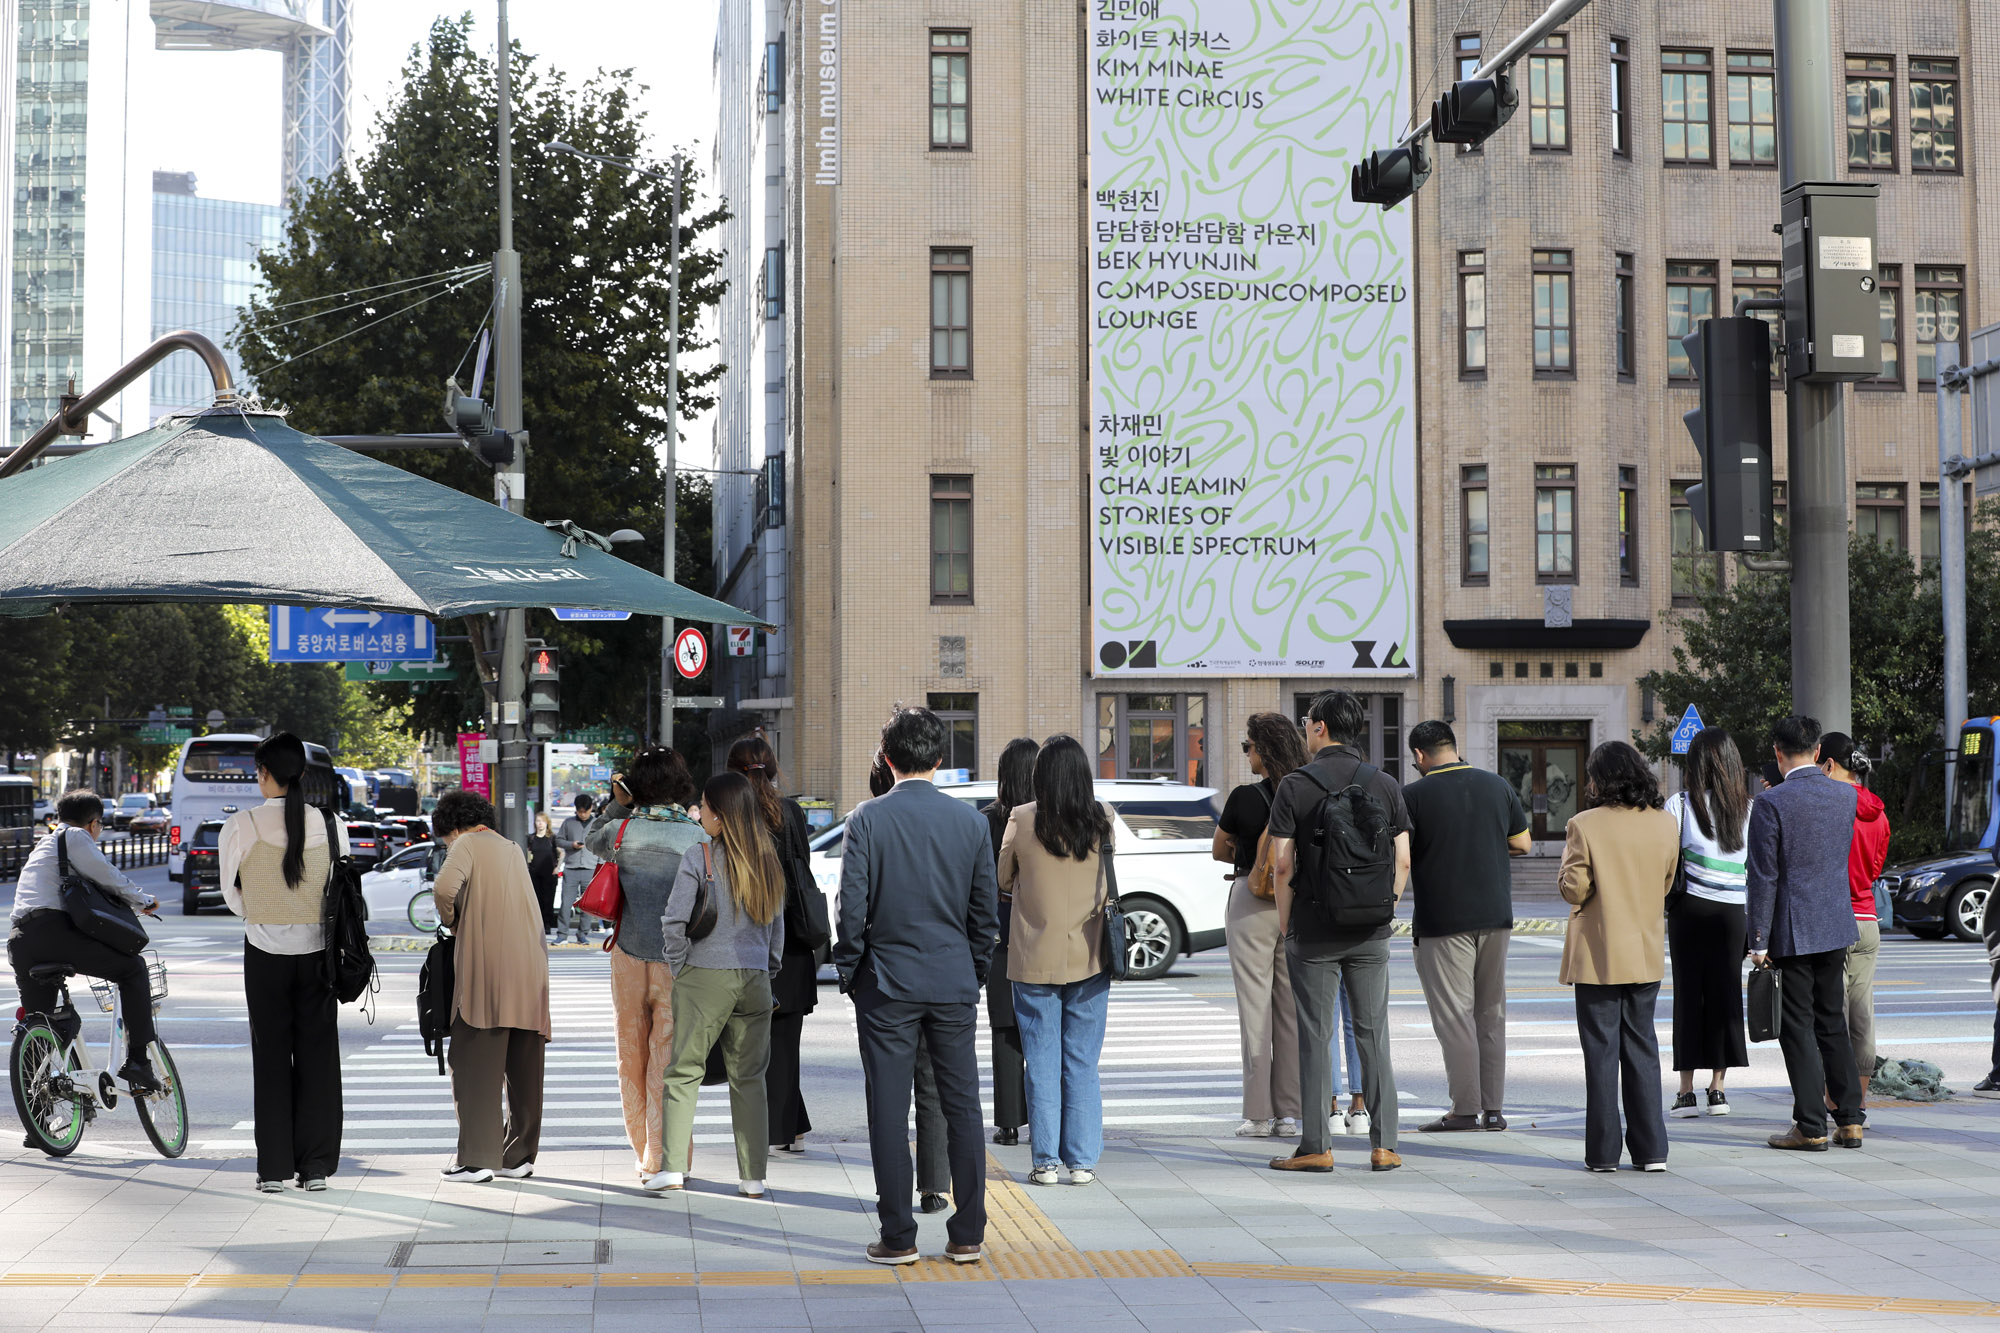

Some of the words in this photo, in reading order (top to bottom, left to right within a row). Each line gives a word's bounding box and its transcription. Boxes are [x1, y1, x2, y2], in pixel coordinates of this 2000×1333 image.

[1097, 0, 1159, 21] 김민애
[1096, 29, 1158, 51] 화이트
[1168, 30, 1231, 52] 서커스
[819, 13, 836, 118] museum
[1097, 59, 1139, 77] KIM
[1148, 60, 1223, 79] MINAE
[1097, 88, 1170, 107] WHITE
[1177, 89, 1264, 109] CIRCUS
[815, 126, 836, 185] ilmin
[1096, 190, 1159, 212] 백현진
[1096, 221, 1247, 245] 담담함안담담함
[1254, 223, 1316, 246] 라운지
[1098, 251, 1142, 270] BEK
[1149, 252, 1256, 271] HYUNJIN
[1097, 280, 1407, 303] COMPOSEDUNCOMPOSED
[1098, 310, 1198, 330] LOUNGE
[1099, 413, 1162, 437] 차재민
[1099, 444, 1119, 469] 빛
[1127, 444, 1190, 469] 이야기
[1099, 476, 1151, 496] CHA
[1156, 476, 1246, 496] JEAMIN
[1099, 506, 1193, 526] STORIES
[1200, 506, 1233, 526] OF
[1099, 536, 1185, 555] VISIBLE
[1191, 536, 1316, 556] SPECTRUM
[297, 634, 407, 653] 중앙차로버스전용
